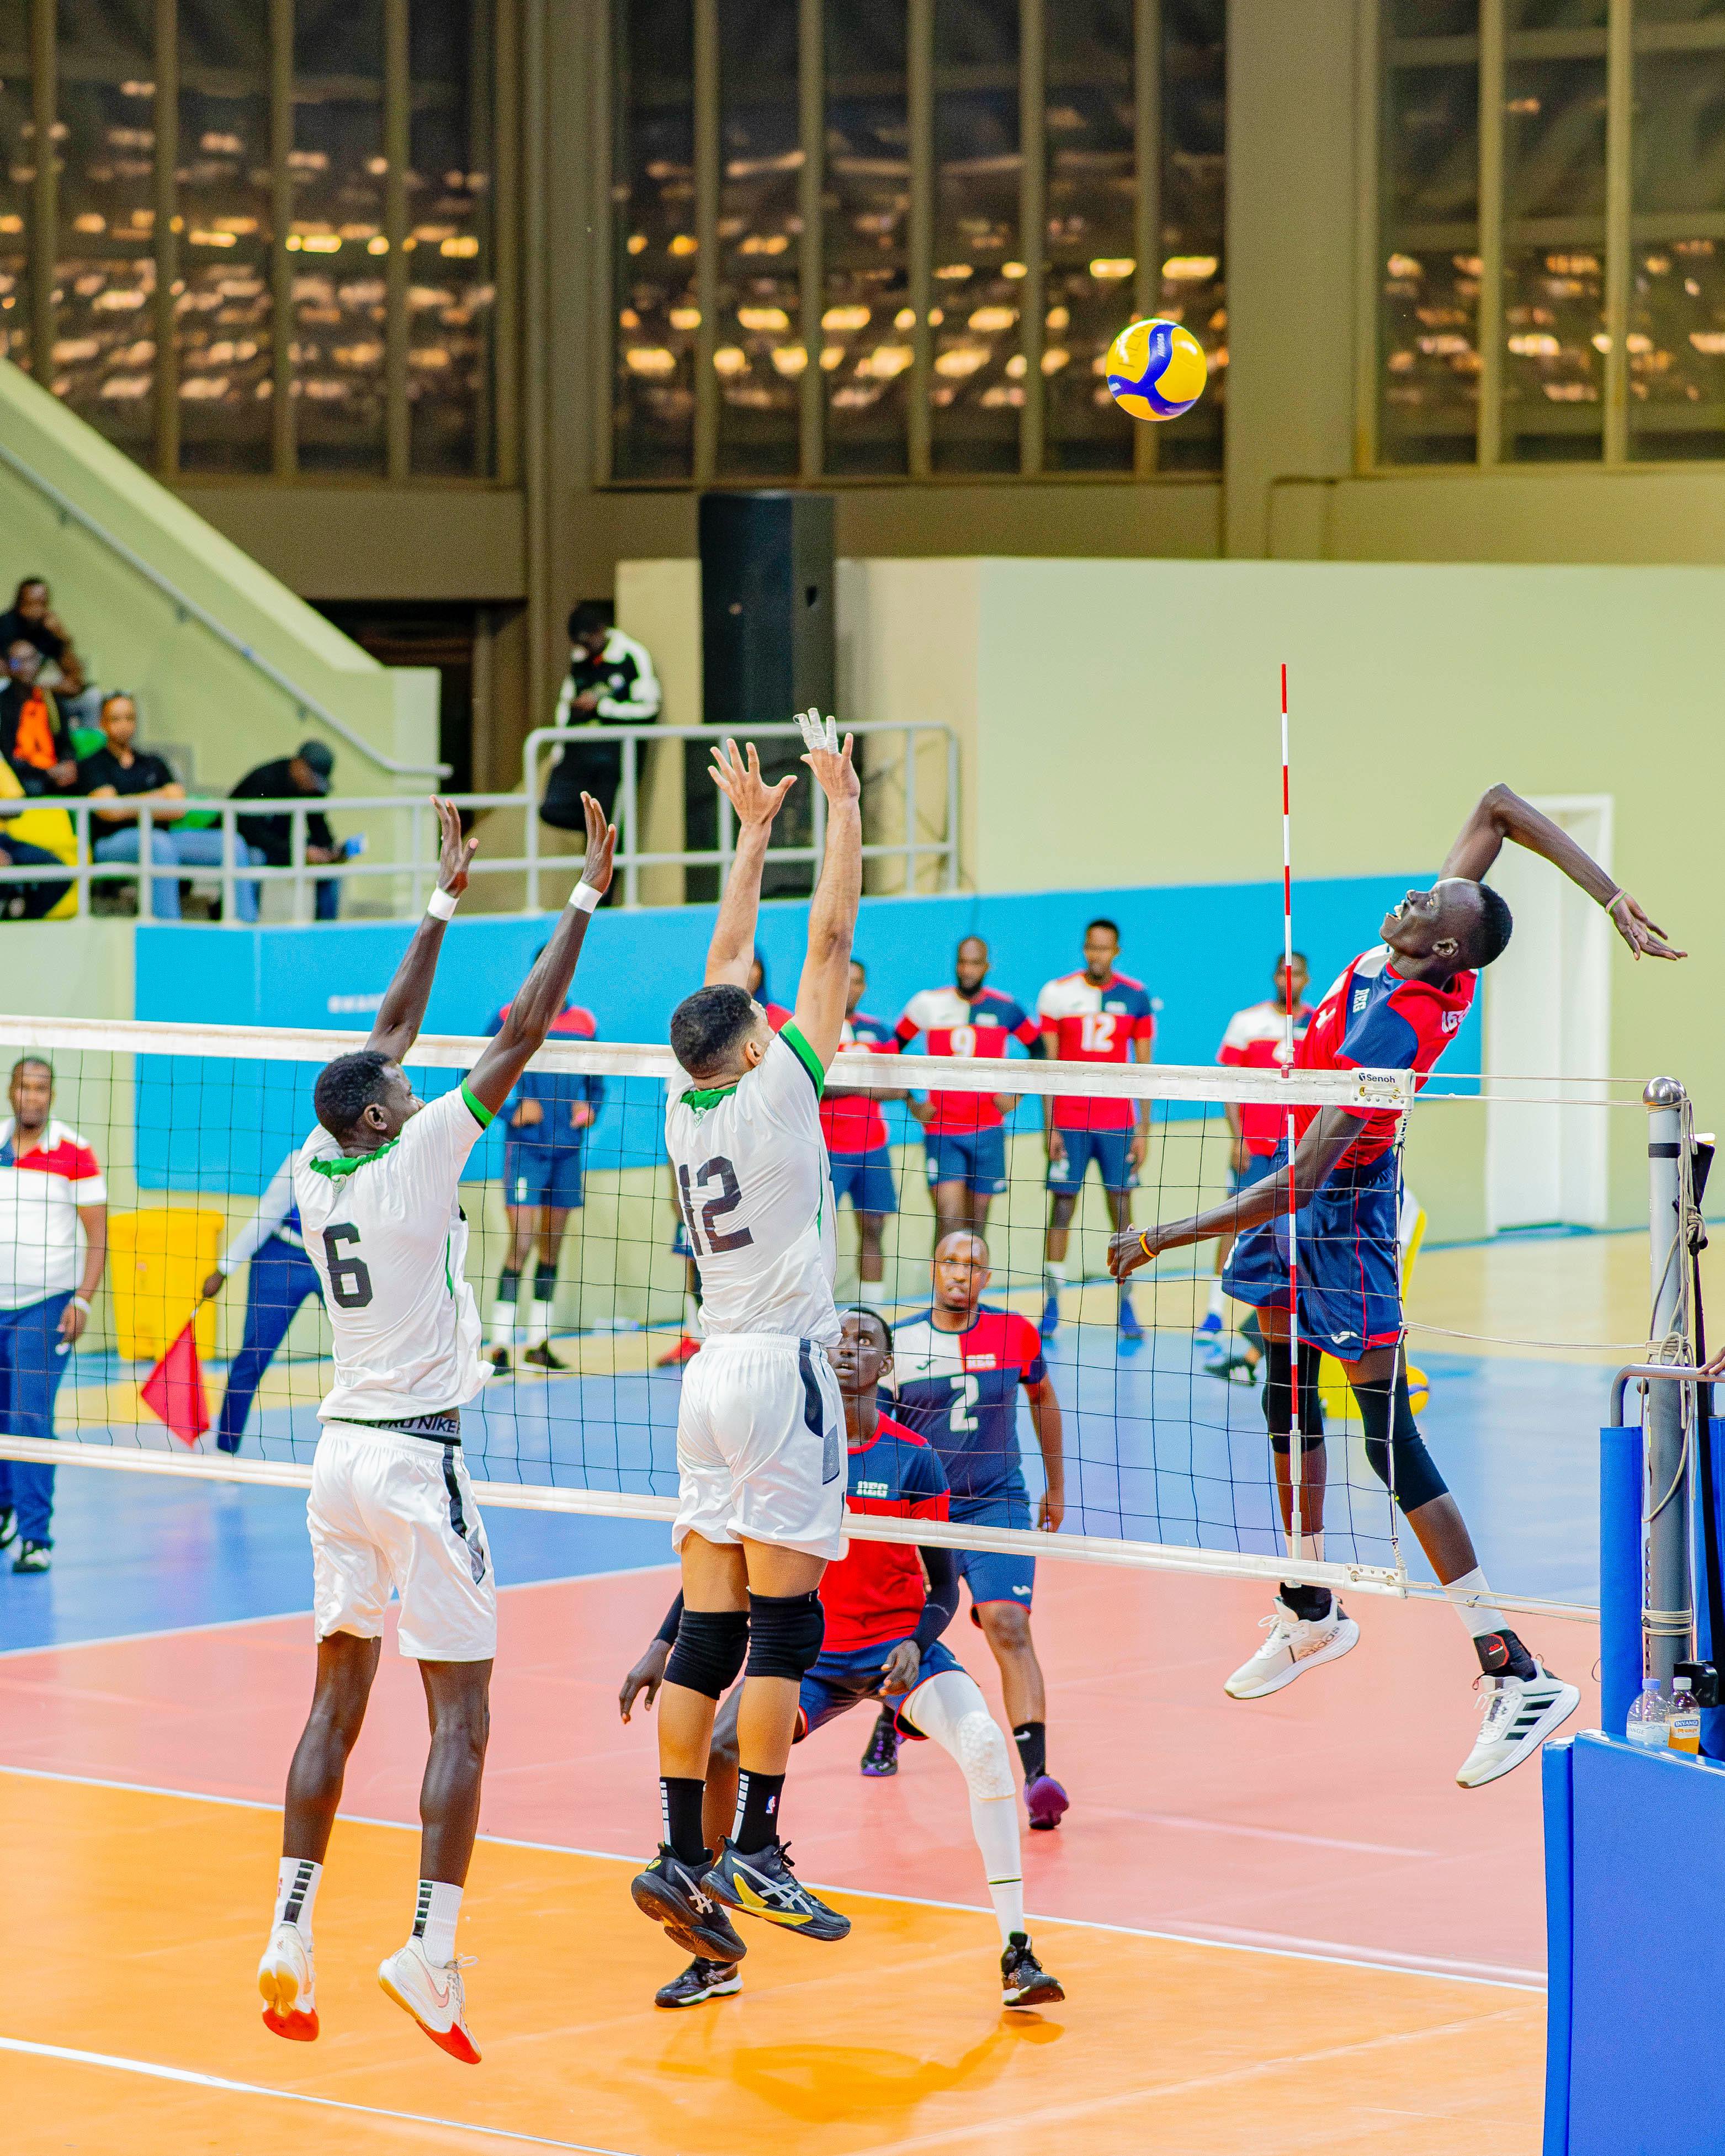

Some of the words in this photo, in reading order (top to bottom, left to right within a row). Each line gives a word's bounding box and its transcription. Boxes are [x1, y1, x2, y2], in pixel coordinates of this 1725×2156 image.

[1353, 988, 1370, 1013] REG
[950, 1027, 976, 1056] 9
[1080, 1015, 1116, 1052] 12
[1367, 1075, 1395, 1083] Senoh
[679, 1156, 754, 1256] 12
[322, 1222, 373, 1308] 6
[949, 1374, 979, 1431] 2
[418, 1416, 456, 1433] NIKE
[857, 1480, 888, 1497] REG
